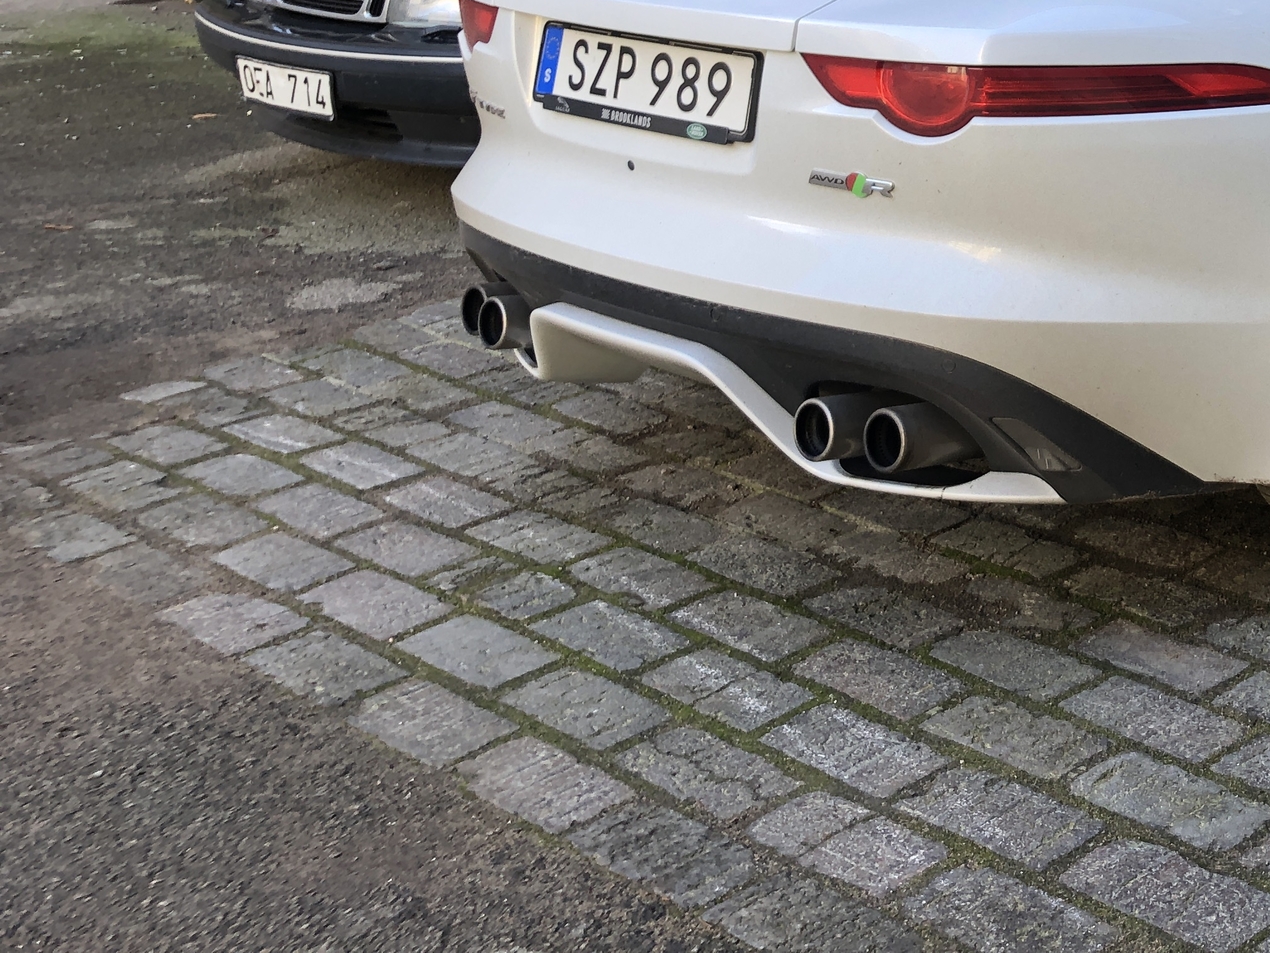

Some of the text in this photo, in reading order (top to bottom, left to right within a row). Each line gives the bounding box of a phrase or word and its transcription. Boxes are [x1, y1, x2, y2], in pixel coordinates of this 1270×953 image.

[543, 68, 552, 83] S
[568, 39, 733, 117] SZP 989
[243, 64, 327, 110] OEA 714
[610, 108, 652, 128] BROOKLANDS
[810, 173, 845, 185] AWD
